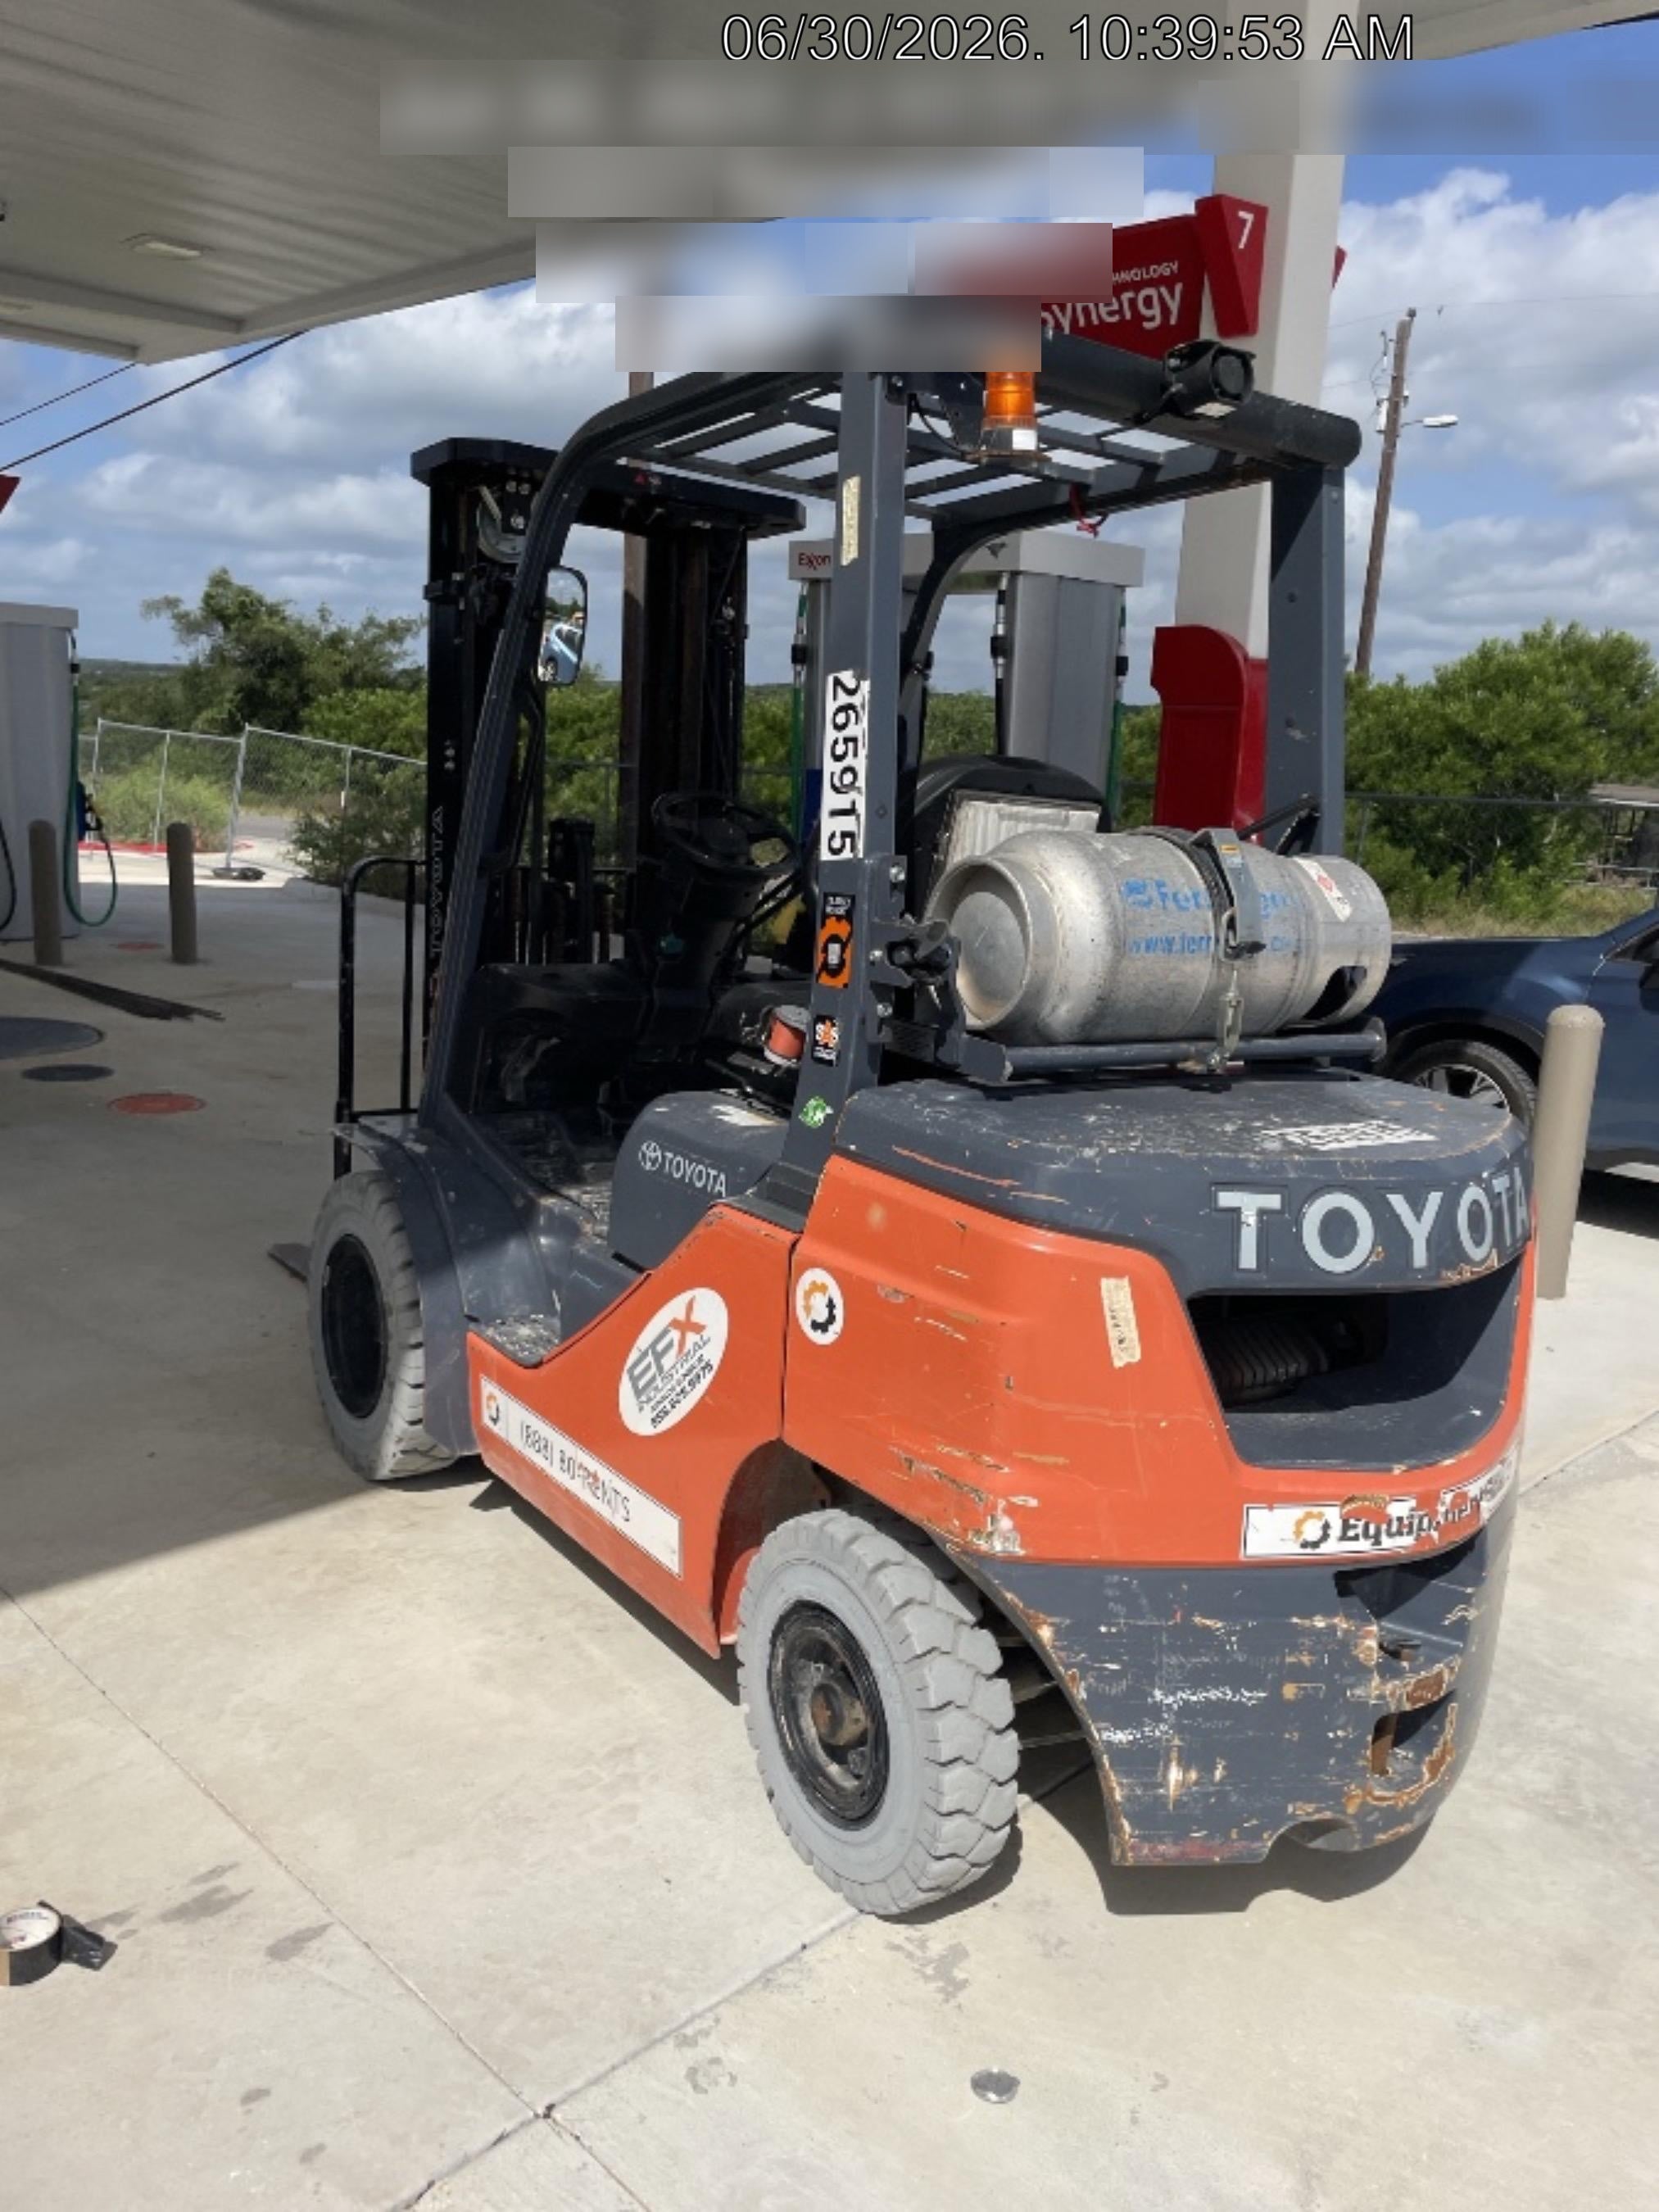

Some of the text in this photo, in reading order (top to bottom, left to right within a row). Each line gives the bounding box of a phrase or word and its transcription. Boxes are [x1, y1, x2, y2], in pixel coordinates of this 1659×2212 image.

[1236, 210, 1255, 250] 7
[799, 552, 832, 571] Exxon
[827, 674, 862, 857] 265915
[430, 805, 444, 955] TOYOTA
[664, 1149, 728, 1197] TOYOTA
[1217, 1167, 1530, 1274] TOYOTA
[626, 1294, 707, 1401] EFX
